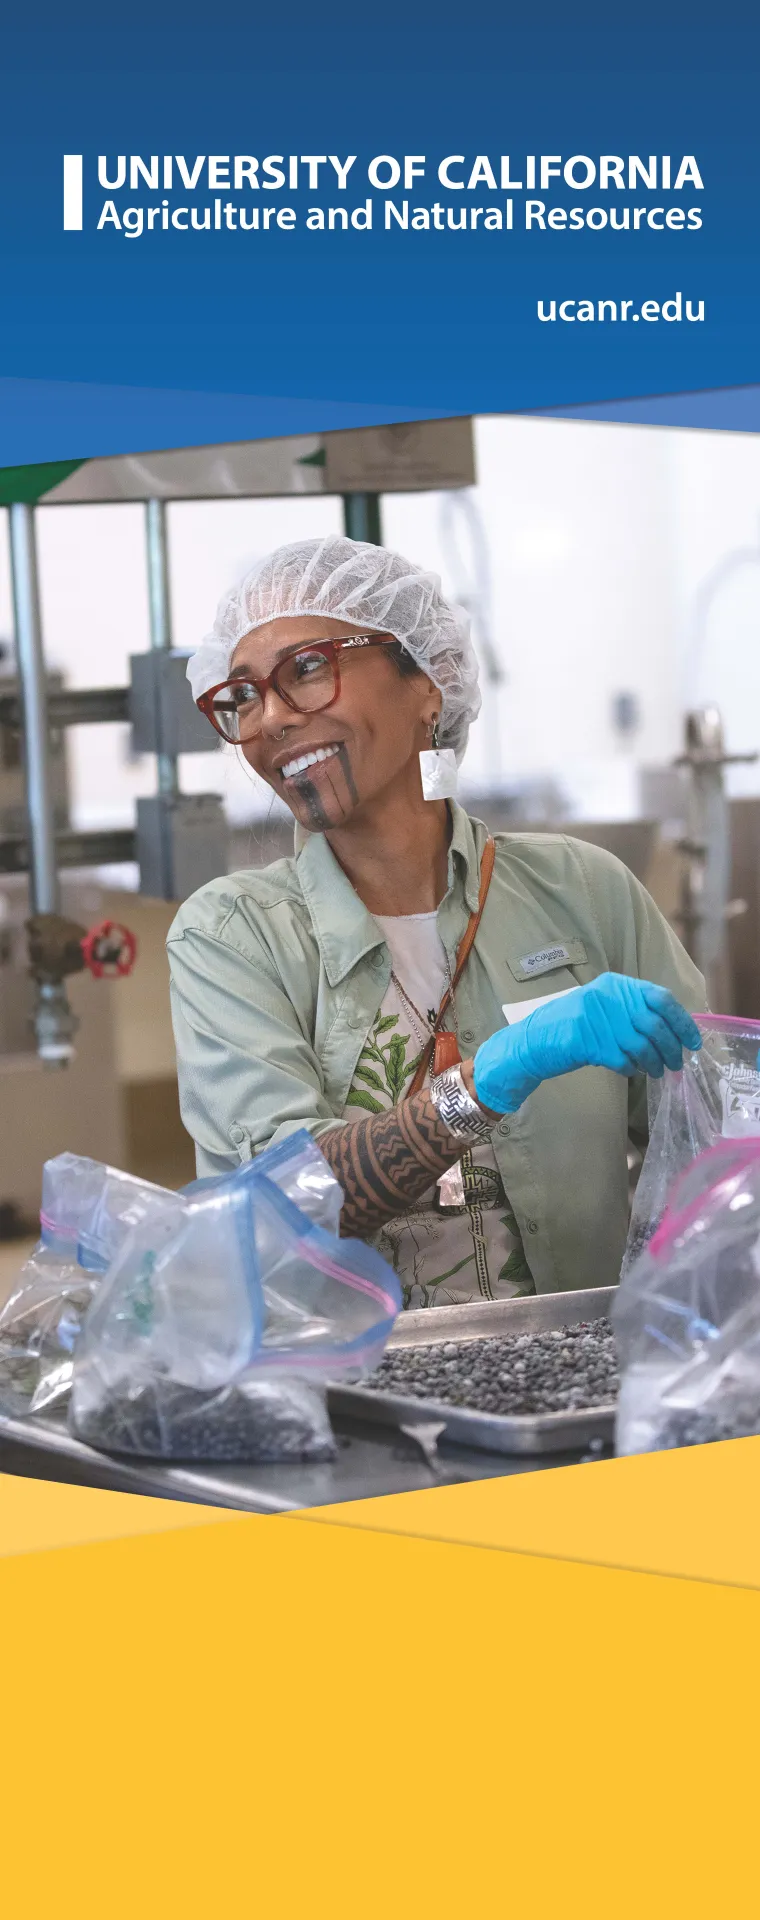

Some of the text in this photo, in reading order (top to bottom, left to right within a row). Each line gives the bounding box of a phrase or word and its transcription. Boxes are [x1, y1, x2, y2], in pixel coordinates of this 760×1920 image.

[97, 154, 705, 190] UNIVERSITY OF CALIFORNIA
[96, 198, 703, 238] Agriculture and Natural Resources
[537, 291, 705, 322] ucanr.edu
[534, 948, 564, 963] Columbia
